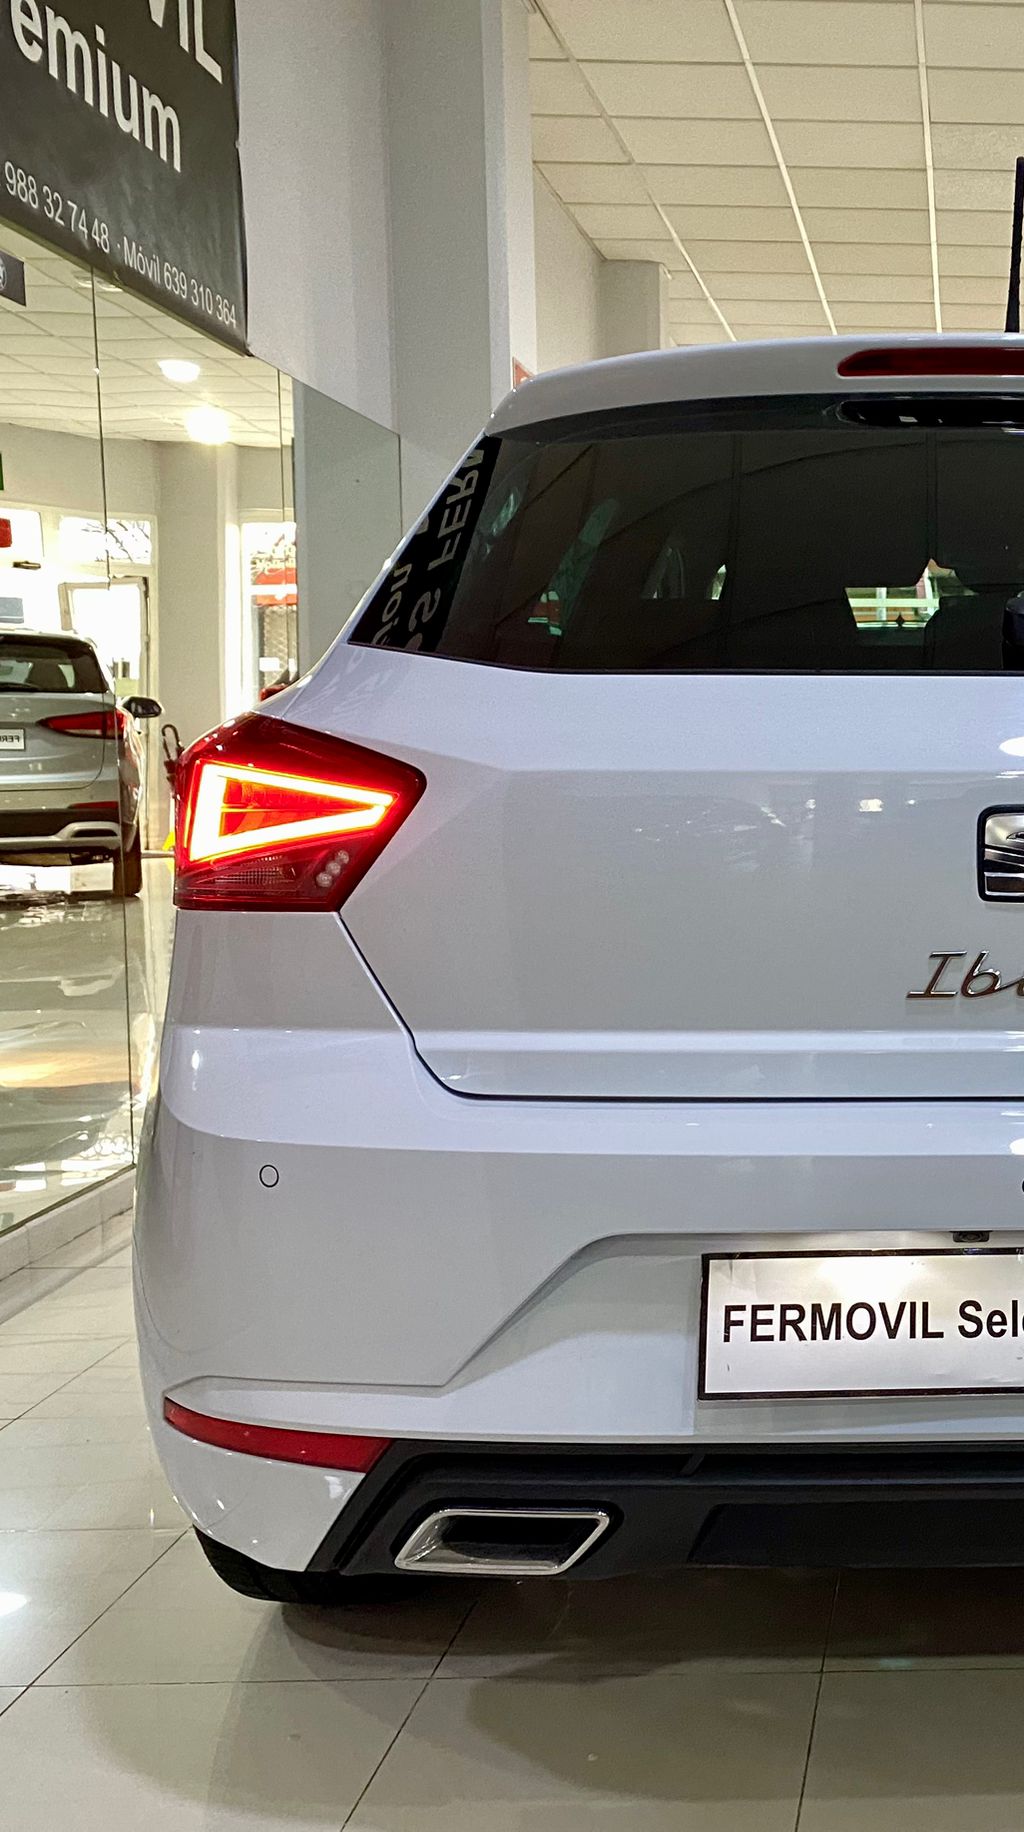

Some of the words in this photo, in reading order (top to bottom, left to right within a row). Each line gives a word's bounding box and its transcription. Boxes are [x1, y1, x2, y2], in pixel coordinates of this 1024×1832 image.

[11, 0, 181, 173] emium
[5, 161, 39, 209] 988
[43, 185, 65, 226] 32
[67, 200, 88, 240] 74
[91, 218, 110, 253] 48
[123, 236, 161, 284] Móvil
[163, 262, 188, 299] 639
[190, 278, 213, 315] 310
[215, 294, 237, 329] 364
[723, 1301, 944, 1343] FERMOVIL
